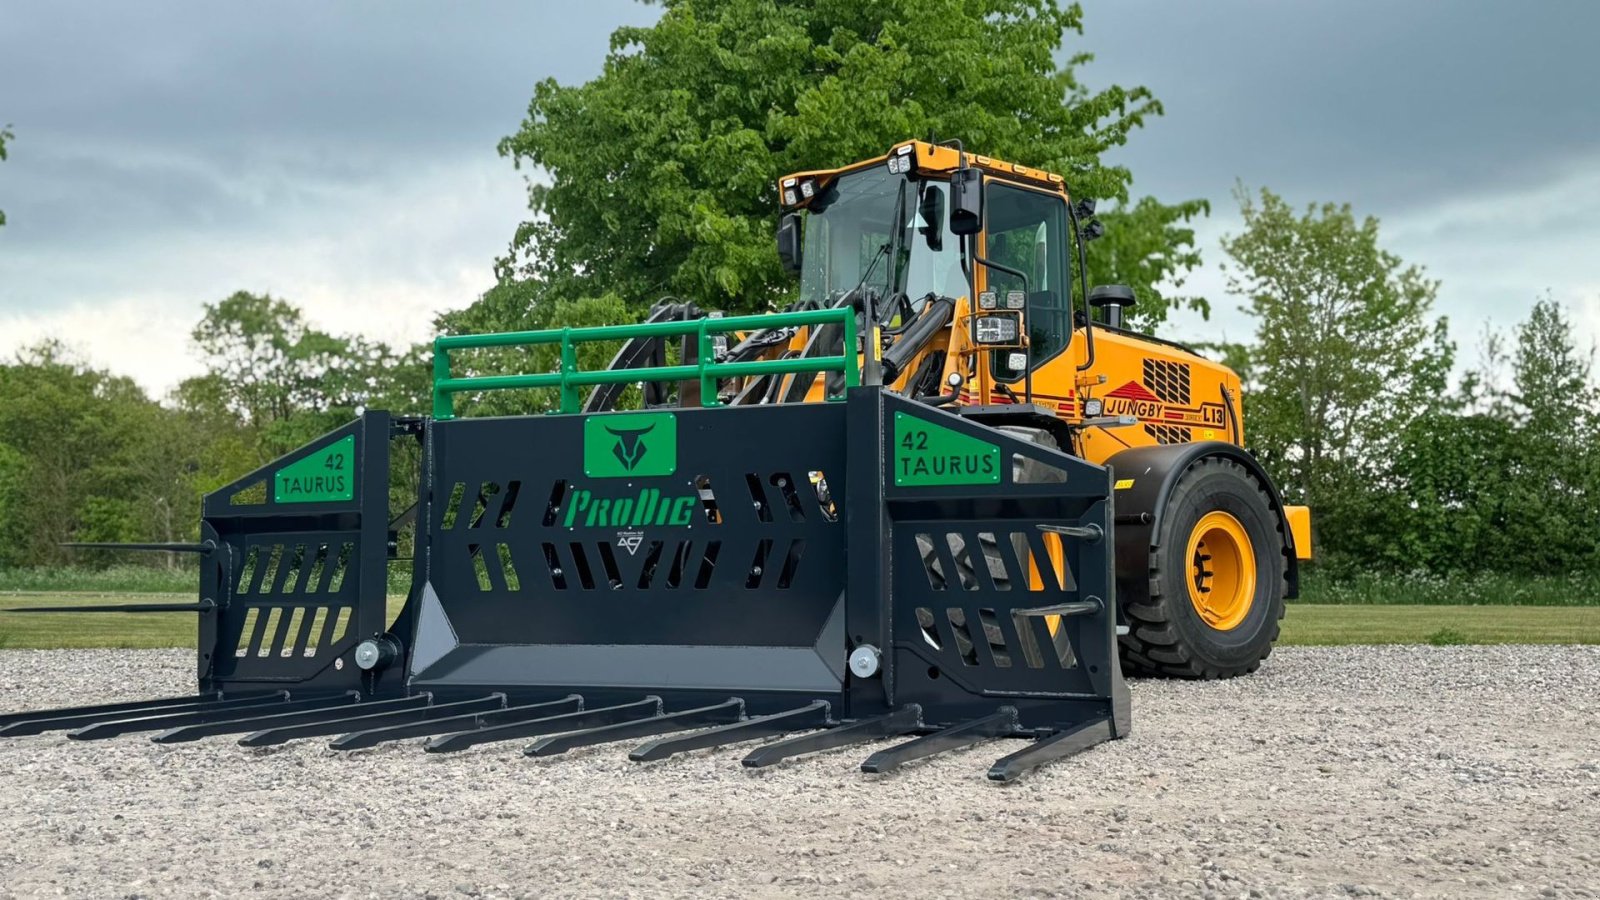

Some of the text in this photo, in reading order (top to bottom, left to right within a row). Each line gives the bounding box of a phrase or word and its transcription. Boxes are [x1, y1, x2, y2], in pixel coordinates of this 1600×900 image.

[901, 431, 928, 450] 42
[324, 453, 344, 471] 42
[902, 454, 993, 476] TAURUS
[282, 475, 345, 494] TAURUS
